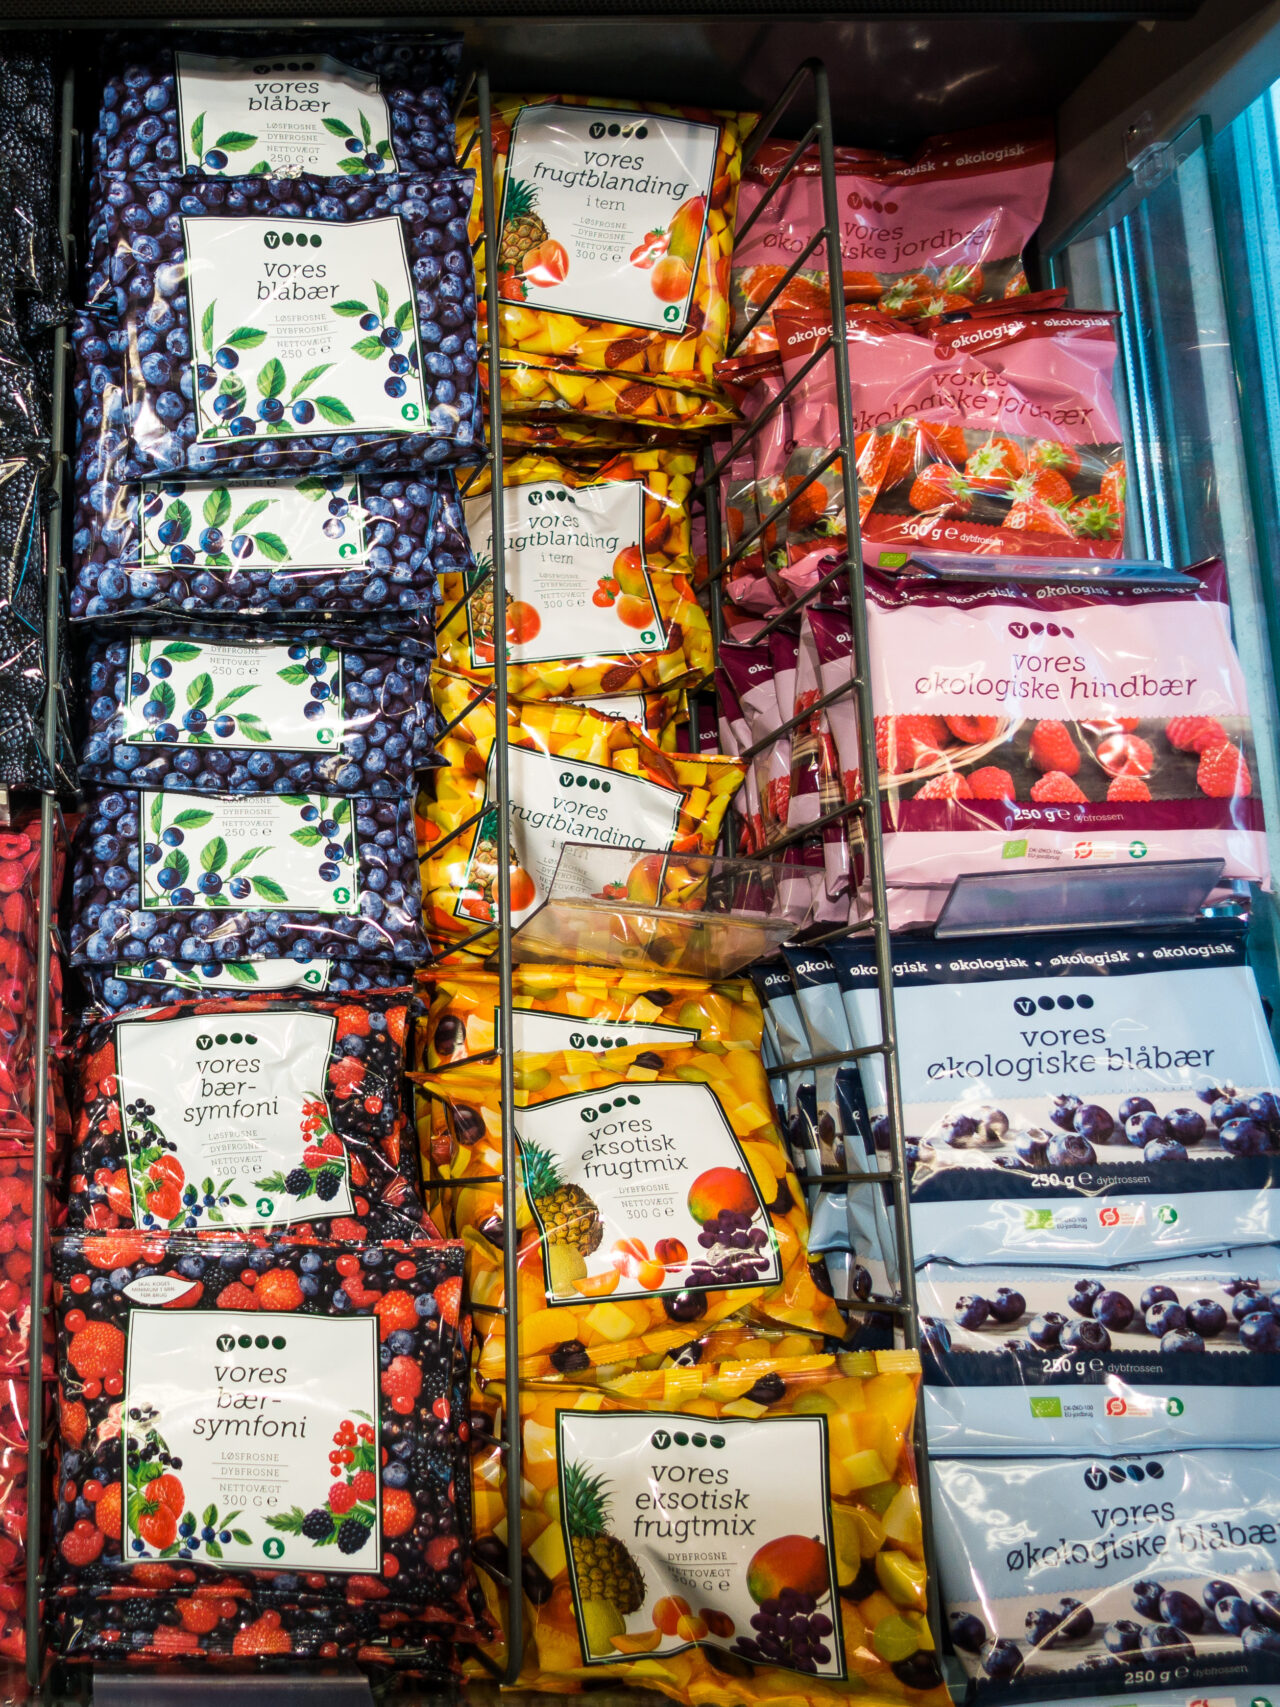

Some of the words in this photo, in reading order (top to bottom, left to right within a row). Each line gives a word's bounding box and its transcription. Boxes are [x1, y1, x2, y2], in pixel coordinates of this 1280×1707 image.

[254, 81, 320, 94] vores
[248, 95, 330, 113] blåbær
[266, 122, 318, 131] LØSFROSNE
[266, 145, 321, 154] NETTOVÆGT
[270, 154, 291, 163] 250
[955, 144, 1027, 167] økologisk
[584, 150, 644, 171] vores
[533, 162, 690, 201] frugtblanding
[595, 195, 625, 211] tern
[843, 221, 904, 240] vores
[575, 249, 596, 261] 300
[762, 231, 888, 262] økoloiske
[263, 262, 327, 279] vores
[786, 316, 860, 346] økologsk
[951, 320, 1026, 348] økologisk
[1043, 316, 1111, 328] økologisk
[281, 349, 303, 359] 250
[528, 514, 579, 529] vores
[899, 522, 927, 537] 300
[931, 528, 941, 540] g
[486, 531, 619, 554] fugtblanding
[1035, 584, 1112, 600] økologisk
[543, 599, 563, 609] 300
[211, 666, 232, 676] 250
[1012, 653, 1087, 673] vores
[914, 672, 1061, 702] økologiske
[1069, 674, 1198, 701] hindbær
[552, 796, 609, 821] vores
[1013, 808, 1041, 821] 250
[1045, 810, 1056, 824] g
[224, 828, 246, 837] 250
[508, 799, 647, 851] frugtblanding
[949, 957, 1029, 972] økologisk
[1050, 950, 1131, 967] økologisk
[1152, 942, 1236, 960] økologisk
[1020, 1027, 1107, 1047] vores
[196, 1057, 261, 1075] vores
[926, 1050, 1097, 1081] økologiske
[1105, 1045, 1216, 1071] blåbær
[201, 1079, 257, 1097] bær-
[183, 1095, 279, 1127] symfoni
[589, 1117, 653, 1141] vores
[581, 1134, 677, 1162] eksotisk
[216, 1166, 238, 1177] 300
[583, 1153, 689, 1180] frugtmix
[1031, 1173, 1060, 1187] 250
[1063, 1175, 1075, 1190] g
[626, 1208, 650, 1220] 300
[214, 1365, 288, 1384] vores
[1042, 1357, 1072, 1373] 250
[1075, 1360, 1086, 1375] g
[1107, 1362, 1164, 1375] dybfrossen
[216, 1387, 282, 1410] bær-
[193, 1415, 307, 1440] symfoni
[221, 1451, 280, 1462] LØSFROSNE
[220, 1466, 280, 1478] DYBFROSNE
[651, 1465, 729, 1485] vores
[219, 1483, 282, 1493] NETTOVÆGT
[222, 1494, 248, 1507] 300
[634, 1488, 751, 1510] eksotisk
[1091, 1501, 1176, 1529] vores
[633, 1513, 757, 1543] frugtmix
[667, 1551, 728, 1562] DYBFROSNE
[1006, 1533, 1169, 1572] økologiske
[1124, 1669, 1156, 1686] 250
[1159, 1671, 1171, 1685] g
